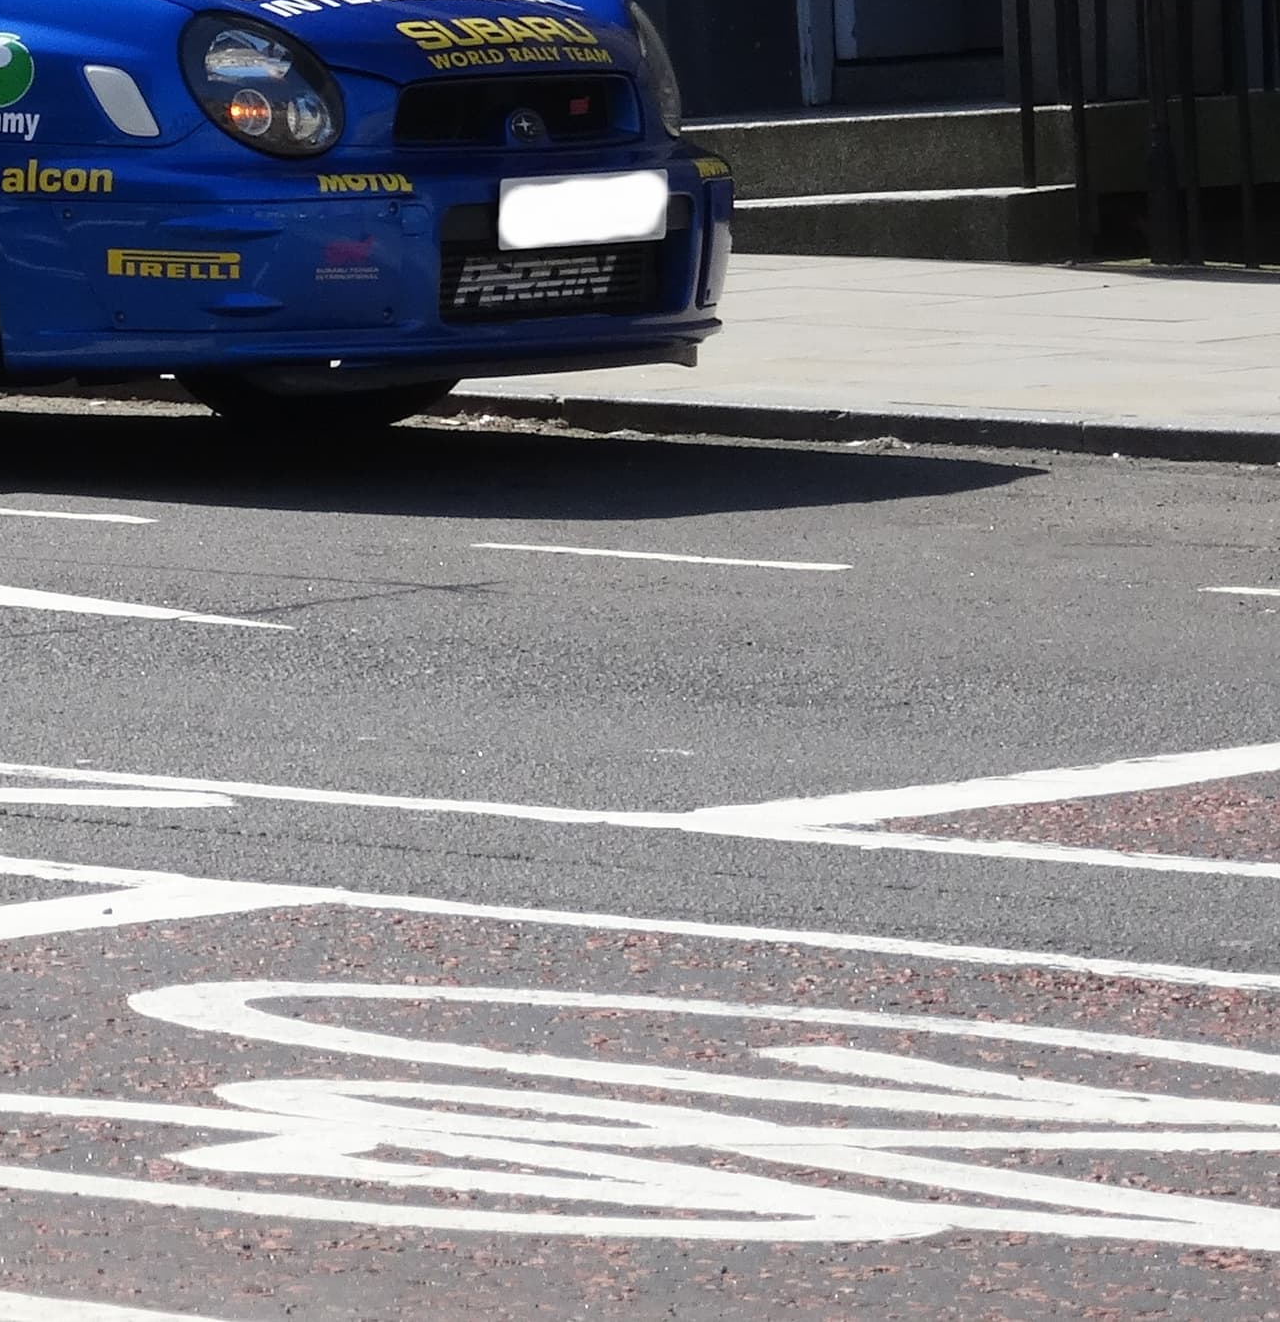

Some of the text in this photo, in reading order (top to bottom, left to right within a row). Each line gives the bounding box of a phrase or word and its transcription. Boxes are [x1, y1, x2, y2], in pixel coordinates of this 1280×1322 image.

[396, 16, 599, 50] SUBARU
[427, 46, 613, 70] WORLD RALLY TEAM
[0, 158, 114, 193] alcon
[317, 173, 413, 192] MOTUL
[107, 249, 241, 279] PIRELLI
